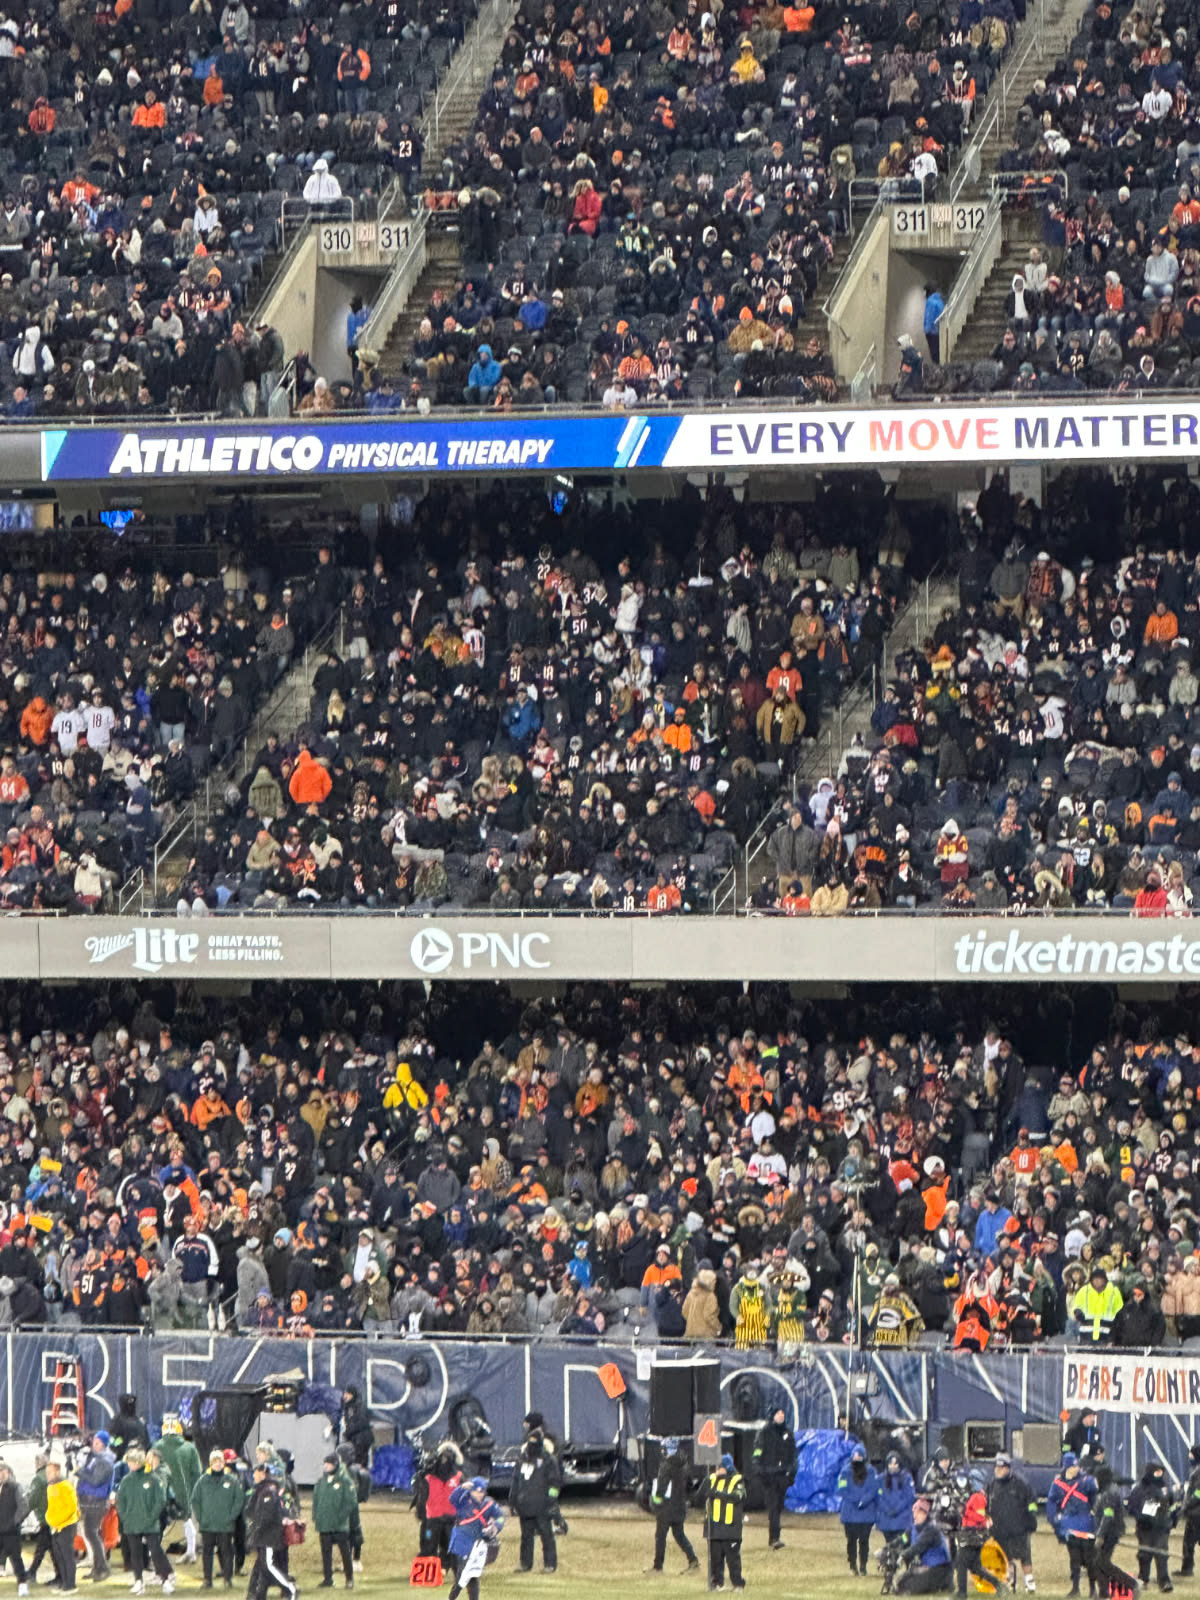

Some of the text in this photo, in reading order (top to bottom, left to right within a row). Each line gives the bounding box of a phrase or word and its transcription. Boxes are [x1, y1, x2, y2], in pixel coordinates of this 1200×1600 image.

[950, 31, 962, 47] 34
[399, 140, 412, 158] 23
[896, 209, 926, 232] 311
[956, 207, 985, 230] 312
[323, 228, 351, 250] 310
[381, 227, 409, 249] 311
[709, 412, 1199, 456] EVERY MOVE MATTER
[108, 433, 554, 474] ATHLETICO PHYSICAL THERAPY
[572, 618, 587, 635] 50
[690, 754, 701, 771] 18
[624, 895, 635, 912] 18
[132, 927, 200, 973] Lite
[208, 935, 243, 948] GREAT
[457, 932, 552, 969] PNC
[954, 929, 1200, 974] ticketmaste
[80, 1274, 94, 1295] 51
[1067, 1363, 1200, 1404] BEARS COUNTR
[697, 1418, 719, 1448] 4
[412, 1561, 437, 1584] 20
